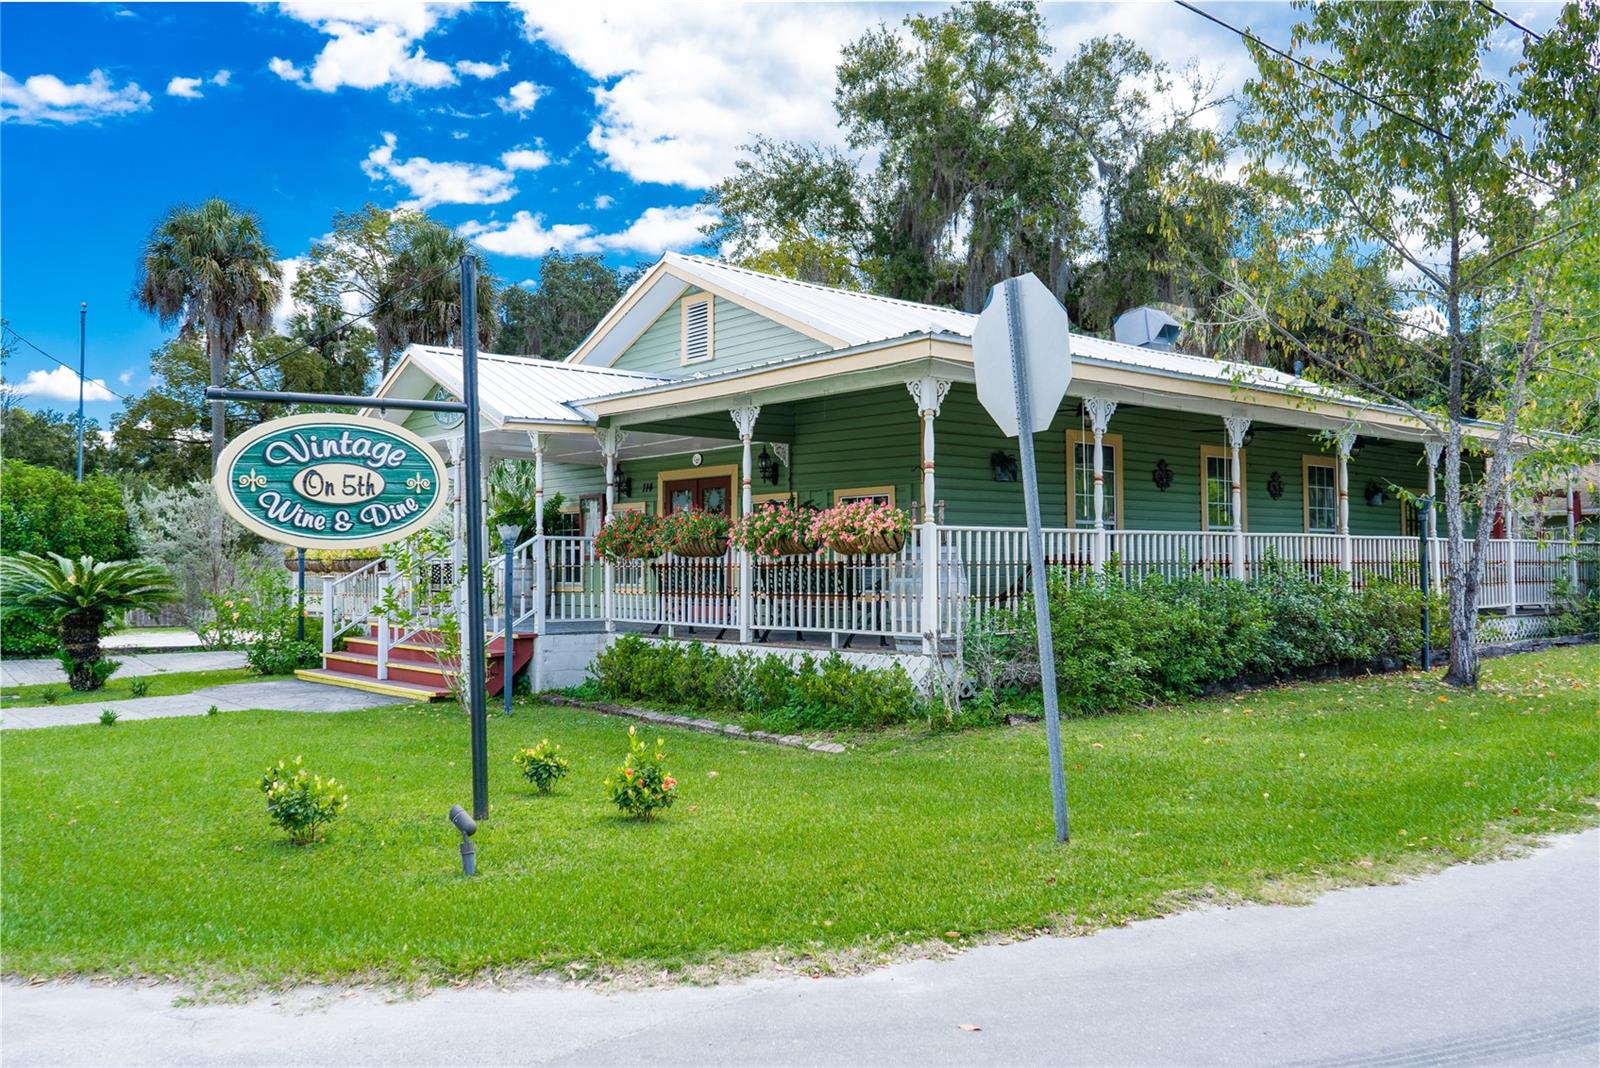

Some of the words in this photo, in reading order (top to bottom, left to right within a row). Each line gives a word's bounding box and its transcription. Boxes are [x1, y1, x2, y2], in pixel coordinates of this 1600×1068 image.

[265, 431, 406, 467] Vintage
[302, 469, 335, 497] On
[341, 472, 376, 497] 5th
[258, 490, 326, 530] Wine
[332, 510, 353, 532] &
[359, 497, 419, 527] Dine
